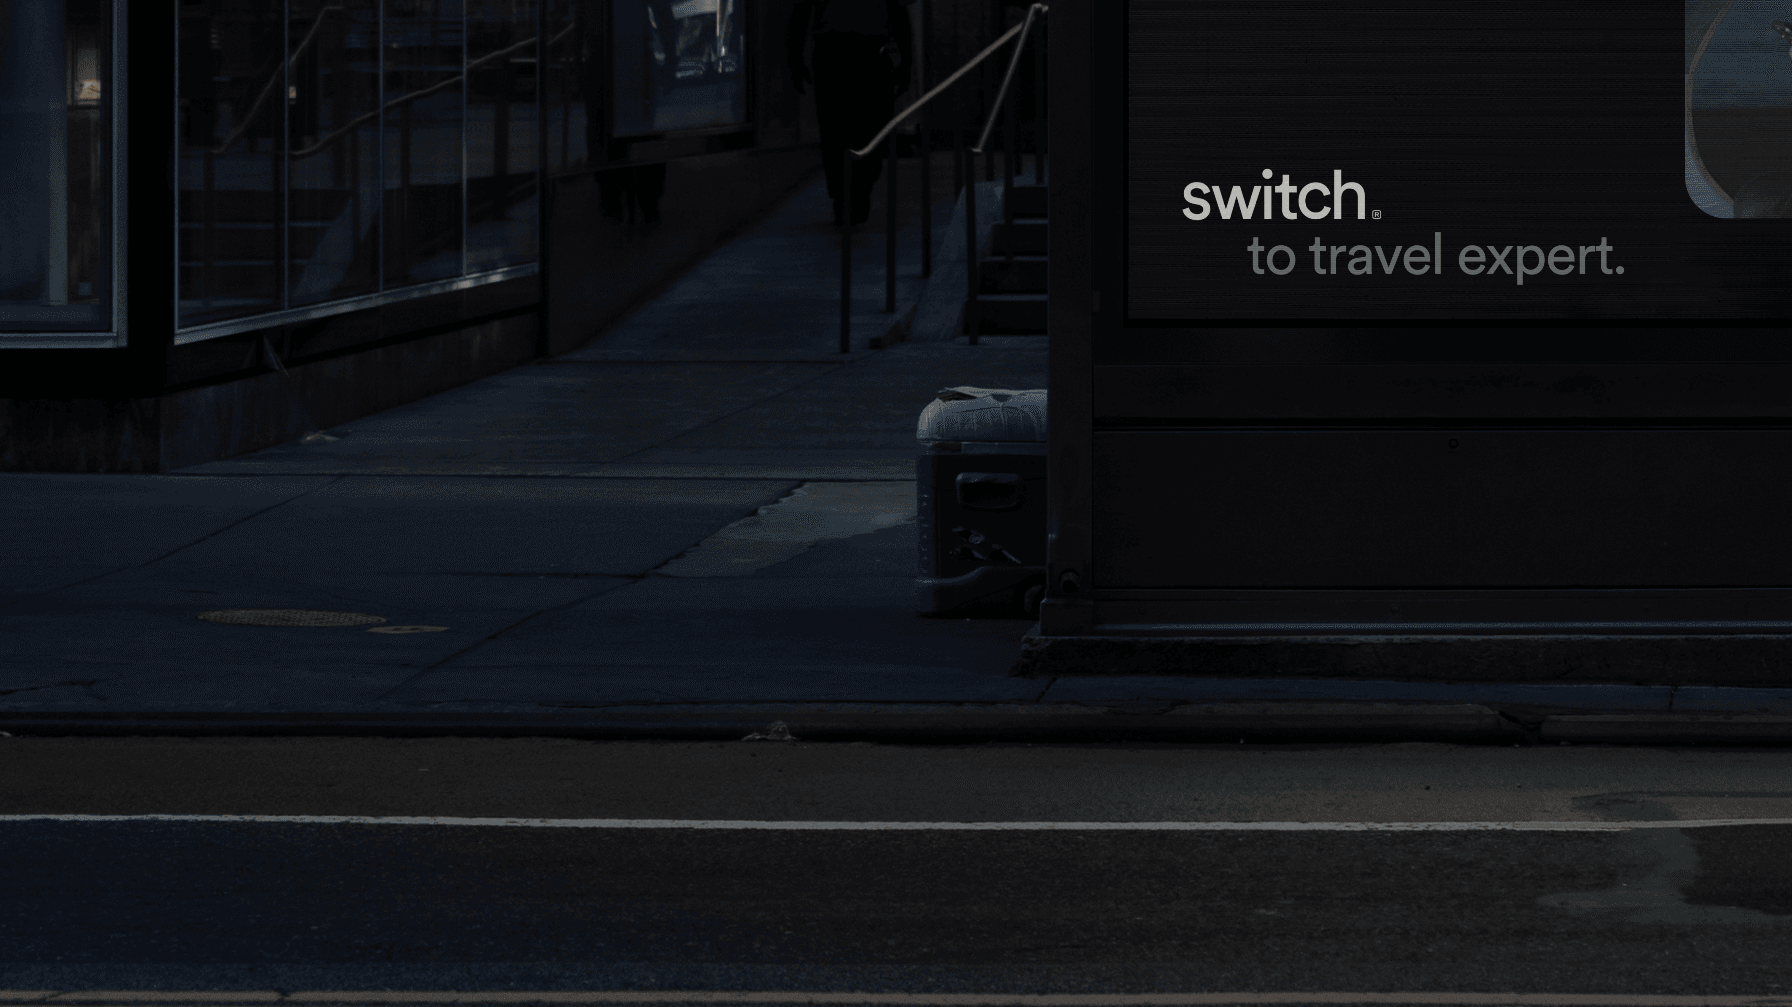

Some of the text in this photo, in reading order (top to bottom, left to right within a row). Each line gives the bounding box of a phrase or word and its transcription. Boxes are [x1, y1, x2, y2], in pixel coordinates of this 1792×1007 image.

[1246, 232, 1625, 286] to travel expert.
